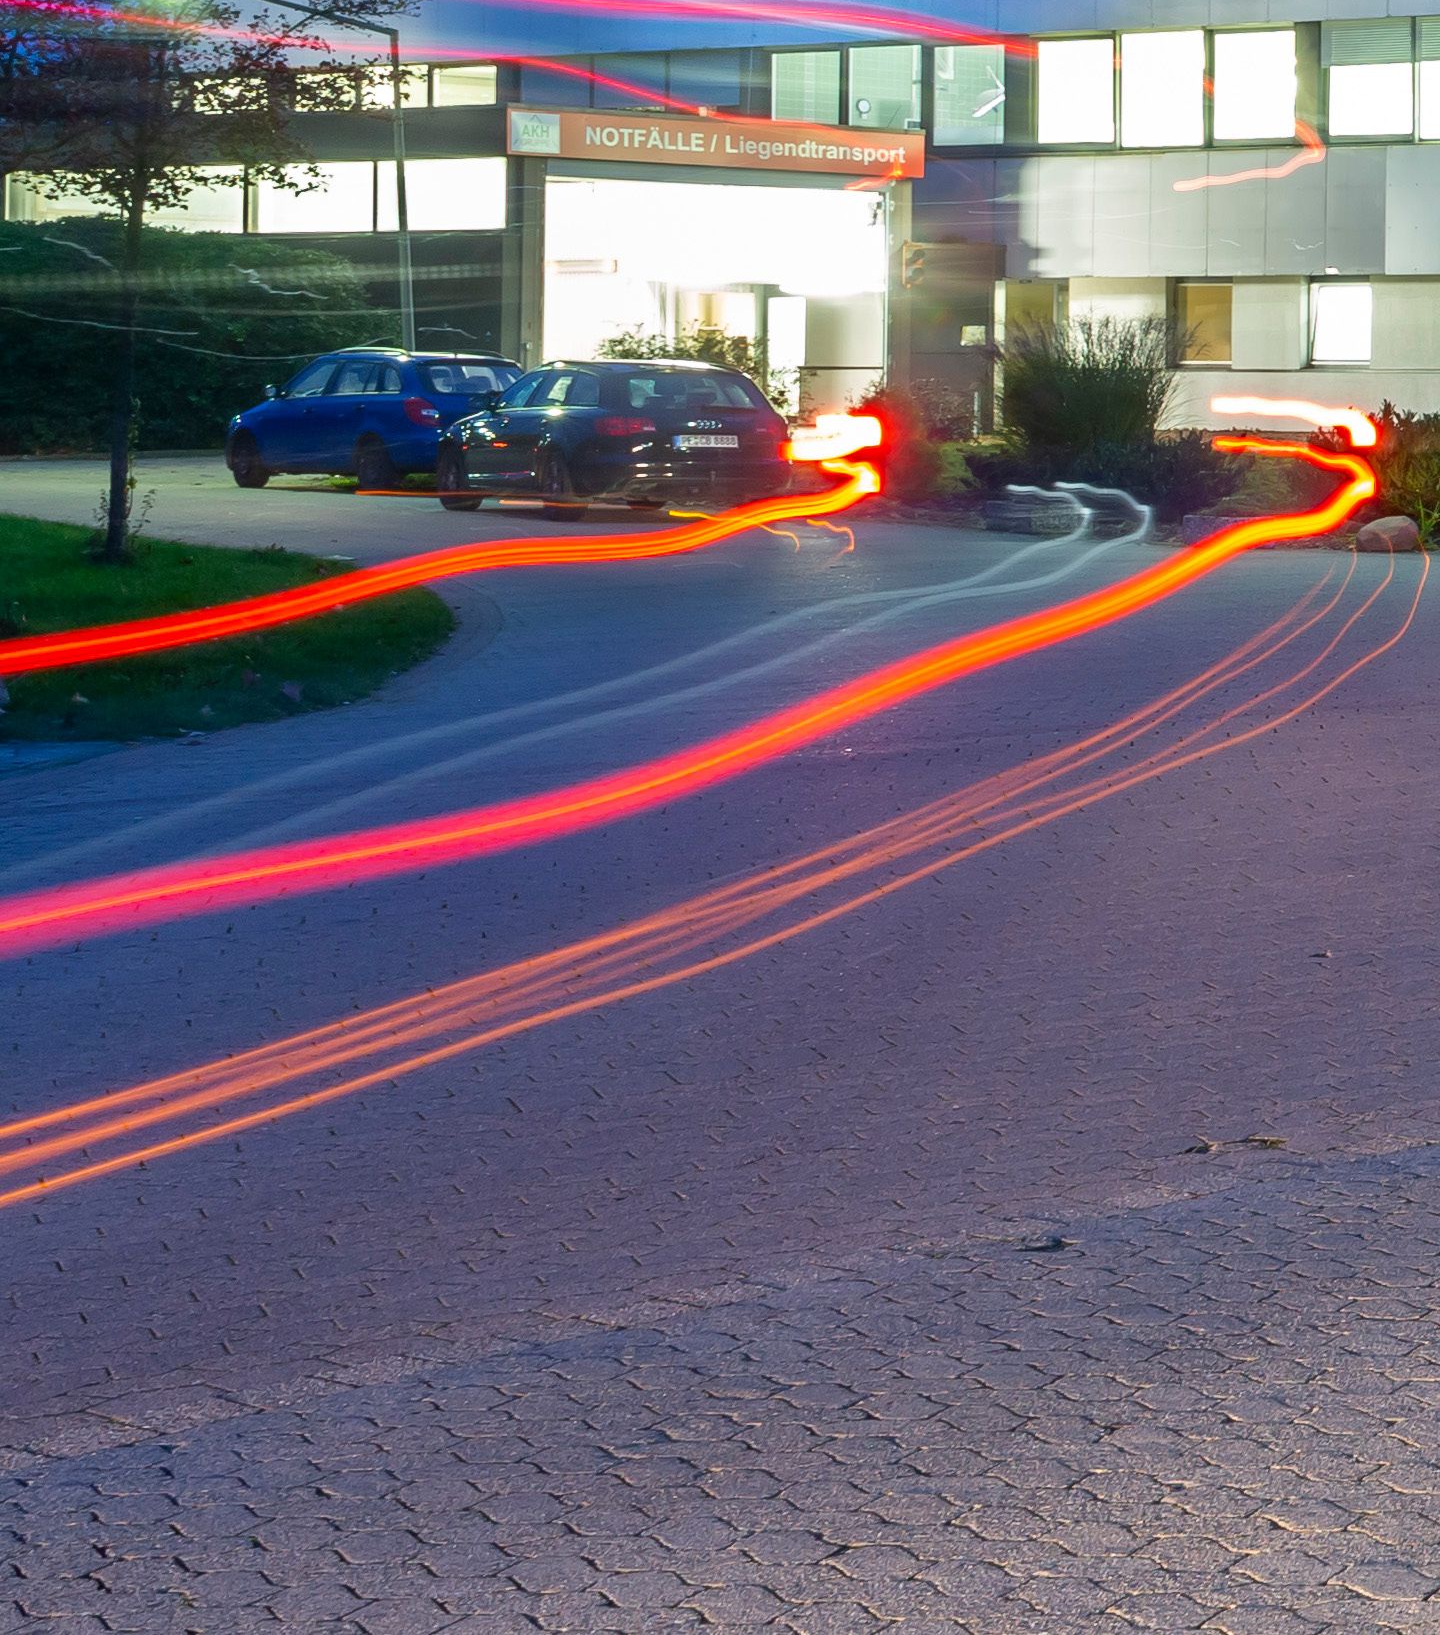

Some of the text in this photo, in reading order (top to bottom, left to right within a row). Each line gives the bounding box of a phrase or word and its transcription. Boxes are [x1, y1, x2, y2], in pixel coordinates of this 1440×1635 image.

[522, 124, 550, 138] AKH
[585, 125, 906, 165] NOTFÄLLE / Liegendtransport
